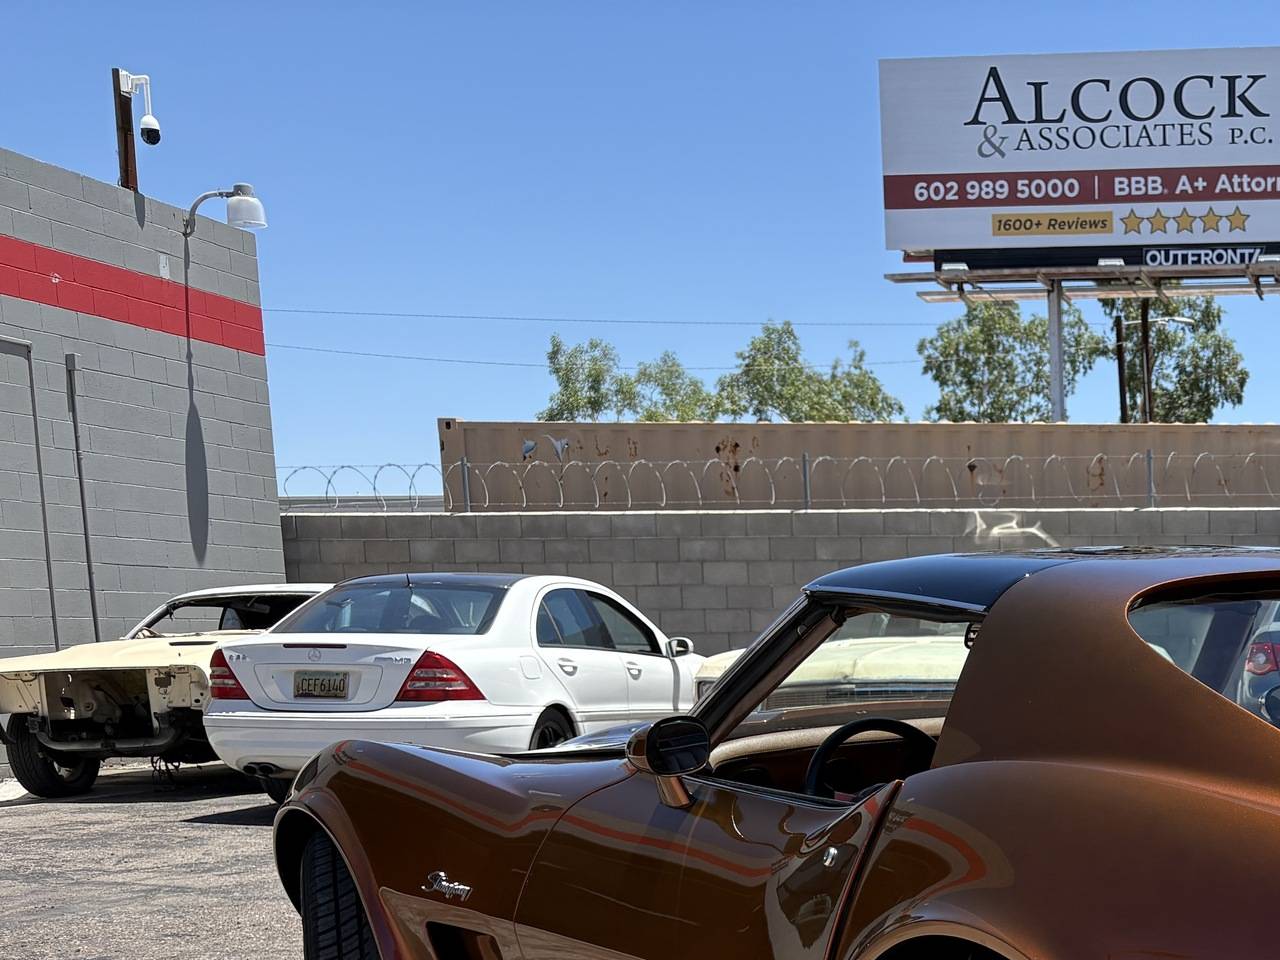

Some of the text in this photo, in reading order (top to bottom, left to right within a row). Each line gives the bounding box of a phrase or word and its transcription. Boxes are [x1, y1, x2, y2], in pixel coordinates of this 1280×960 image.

[963, 66, 1271, 125] ALCOCK
[977, 121, 1274, 158] & ASSOCIATES P.C.
[914, 181, 959, 201] 602
[966, 180, 1009, 200] 989
[1016, 177, 1080, 199] 5000
[1175, 174, 1208, 195] A+
[996, 216, 1108, 232] 1600+ Reviews
[301, 678, 346, 693] CEF6140
